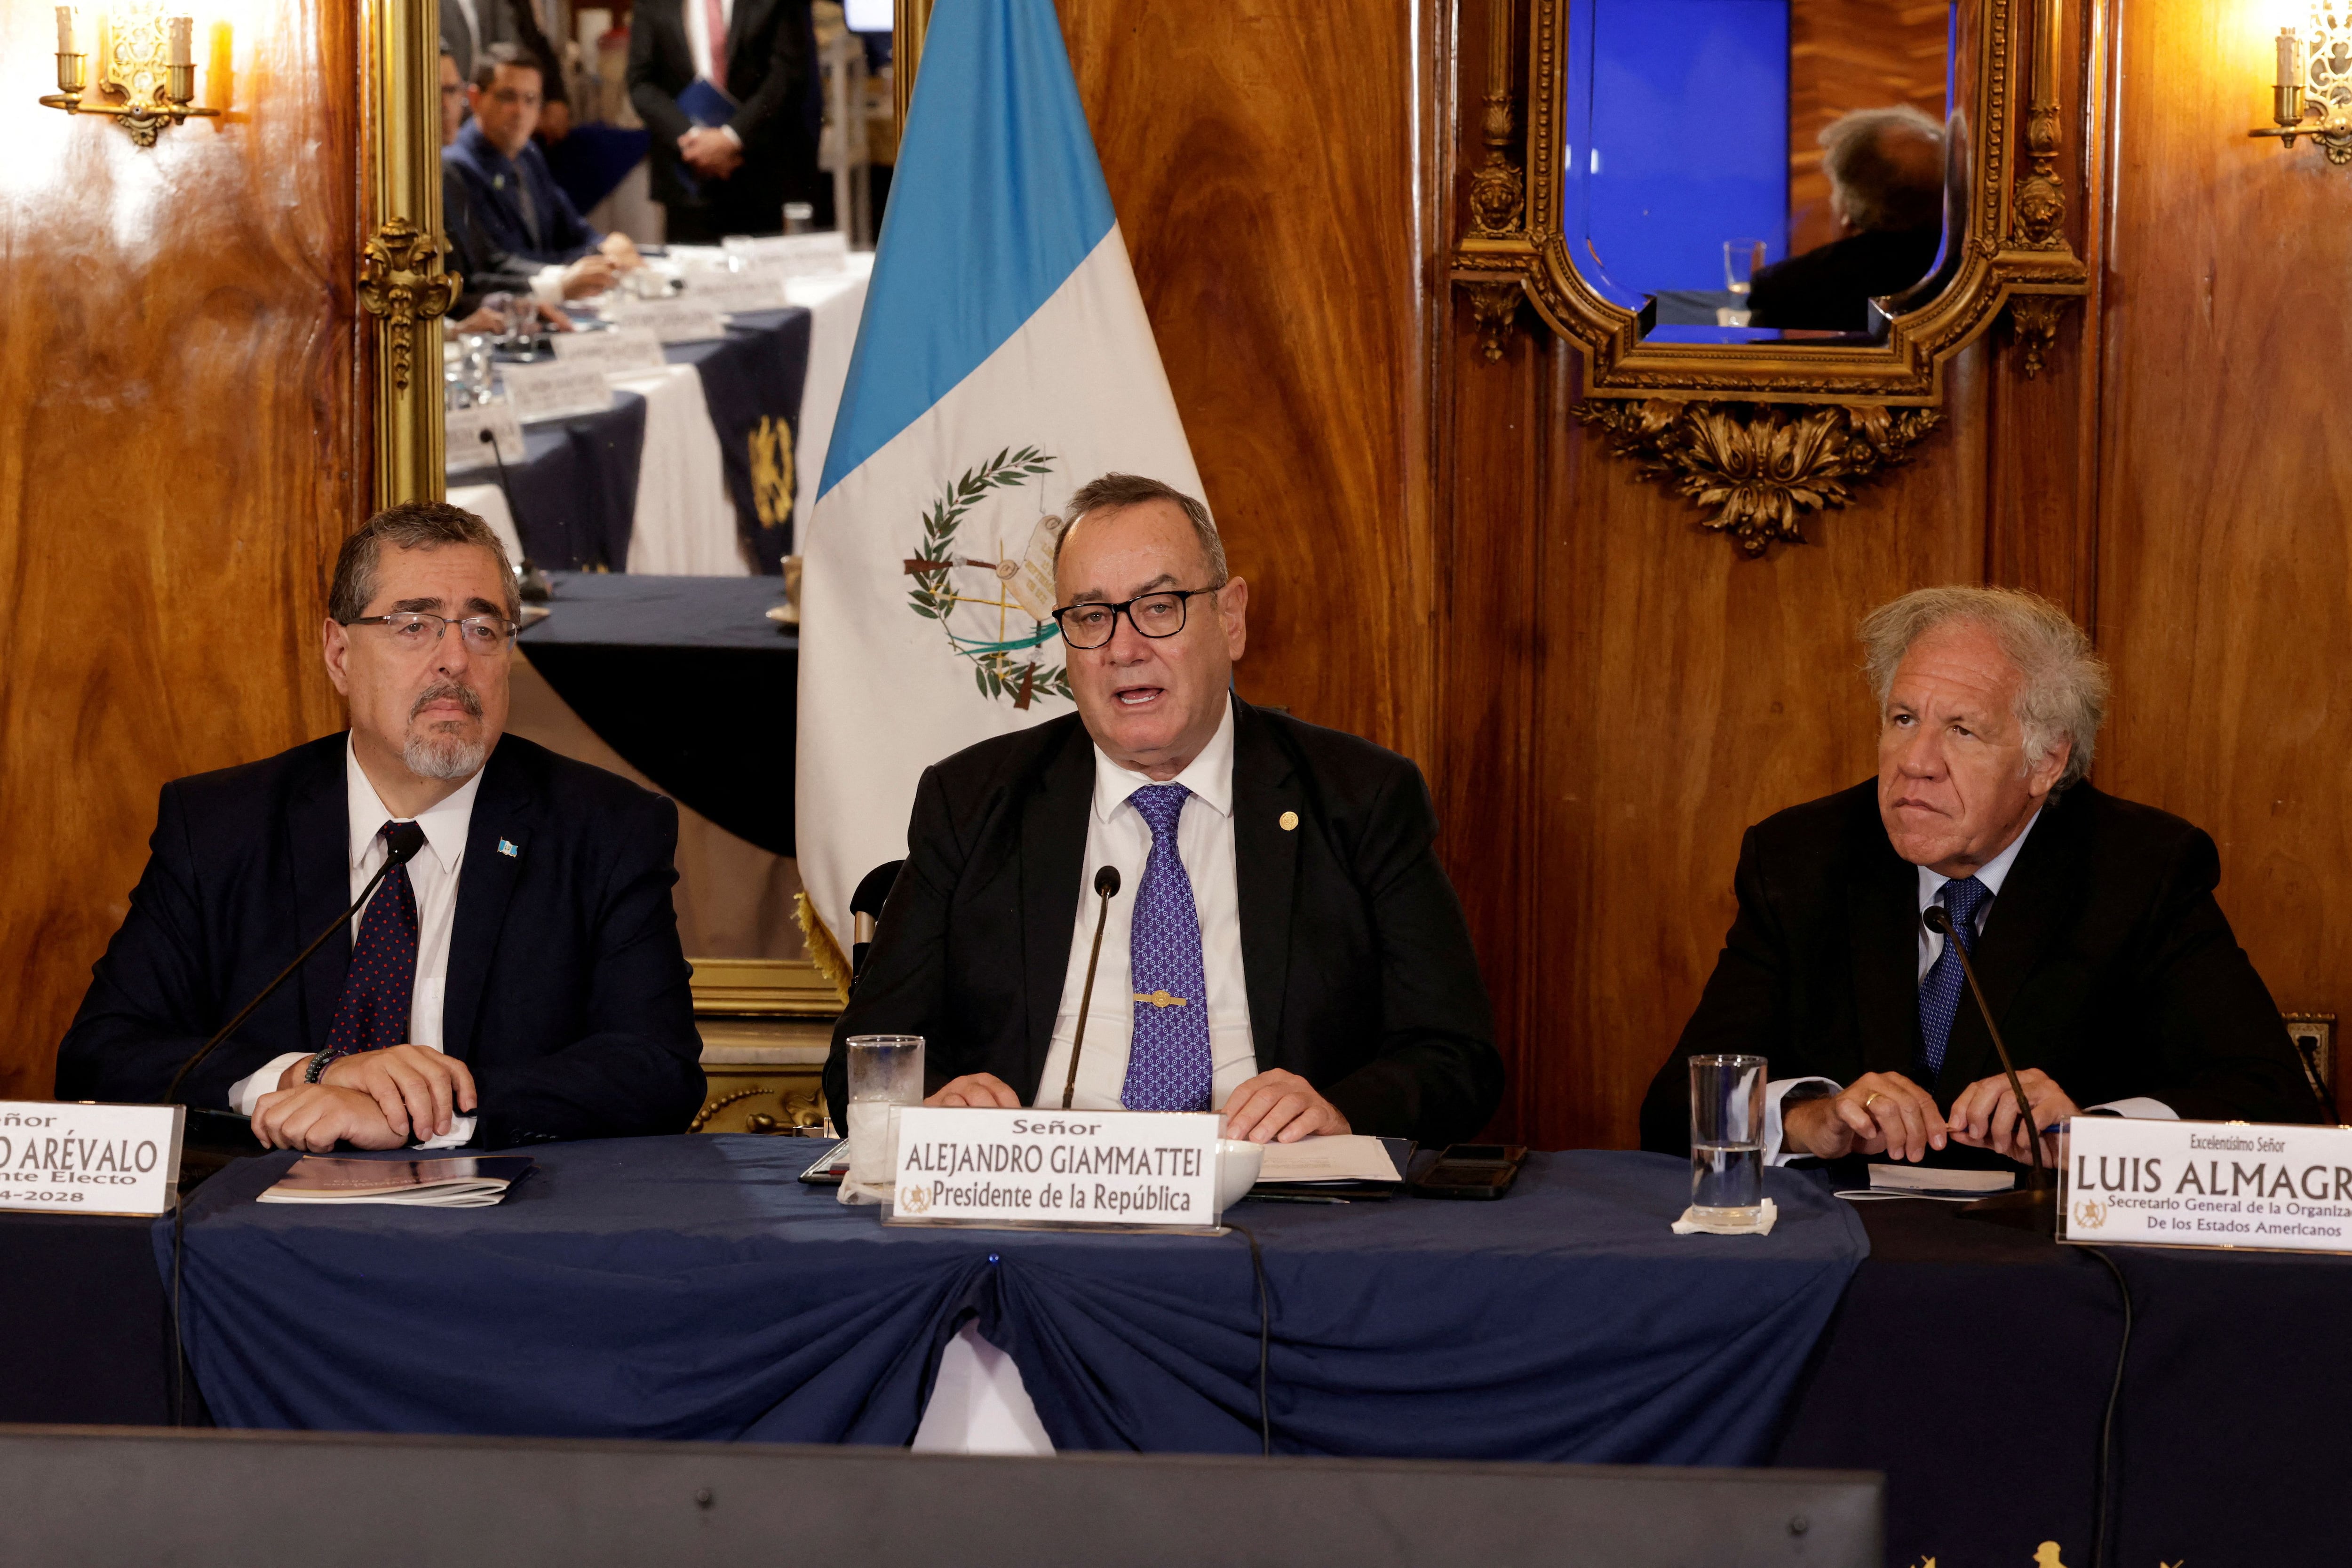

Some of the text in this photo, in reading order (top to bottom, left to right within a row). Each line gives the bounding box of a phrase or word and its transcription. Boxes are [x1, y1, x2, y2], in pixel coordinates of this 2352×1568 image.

[0, 1113, 57, 1128] ñor
[1012, 1119, 1102, 1135] Señor
[18, 1130, 158, 1173] ARÉVALO
[2190, 1133, 2286, 1153] Excelentísimo Señor
[905, 1143, 1202, 1178] ALEJANDRO GIAMMATTEI
[51, 1171, 137, 1185] Electo
[2077, 1154, 2352, 1202] LUIS ALMAGR
[932, 1180, 1191, 1214] Presidente de la República
[2107, 1195, 2352, 1218] Secretario General de la Organiza
[2147, 1216, 2342, 1237] De los Estados Americanos
